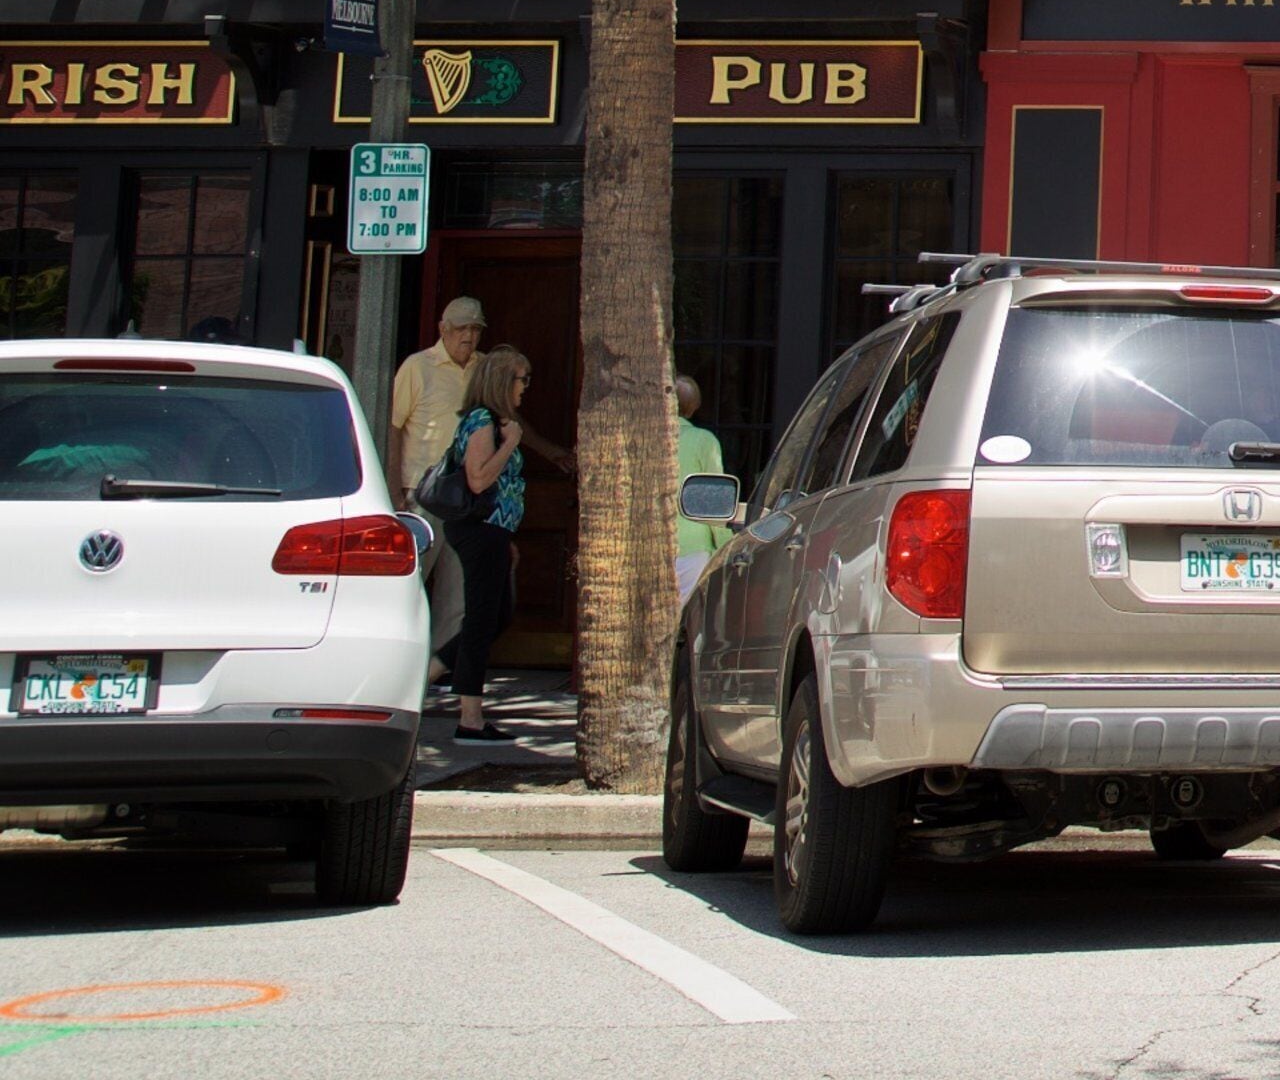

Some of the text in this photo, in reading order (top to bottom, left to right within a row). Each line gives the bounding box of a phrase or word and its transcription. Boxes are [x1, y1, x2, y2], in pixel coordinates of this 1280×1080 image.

[709, 56, 867, 104] PUB
[360, 150, 376, 174] 3
[393, 150, 414, 161] HR.
[383, 163, 424, 173] PARKING
[359, 188, 419, 201] 8:00 AM
[380, 205, 397, 218] TO
[359, 223, 416, 236] 7:00 PM
[1187, 551, 1224, 577] BNT
[26, 672, 139, 700] CKL C54
